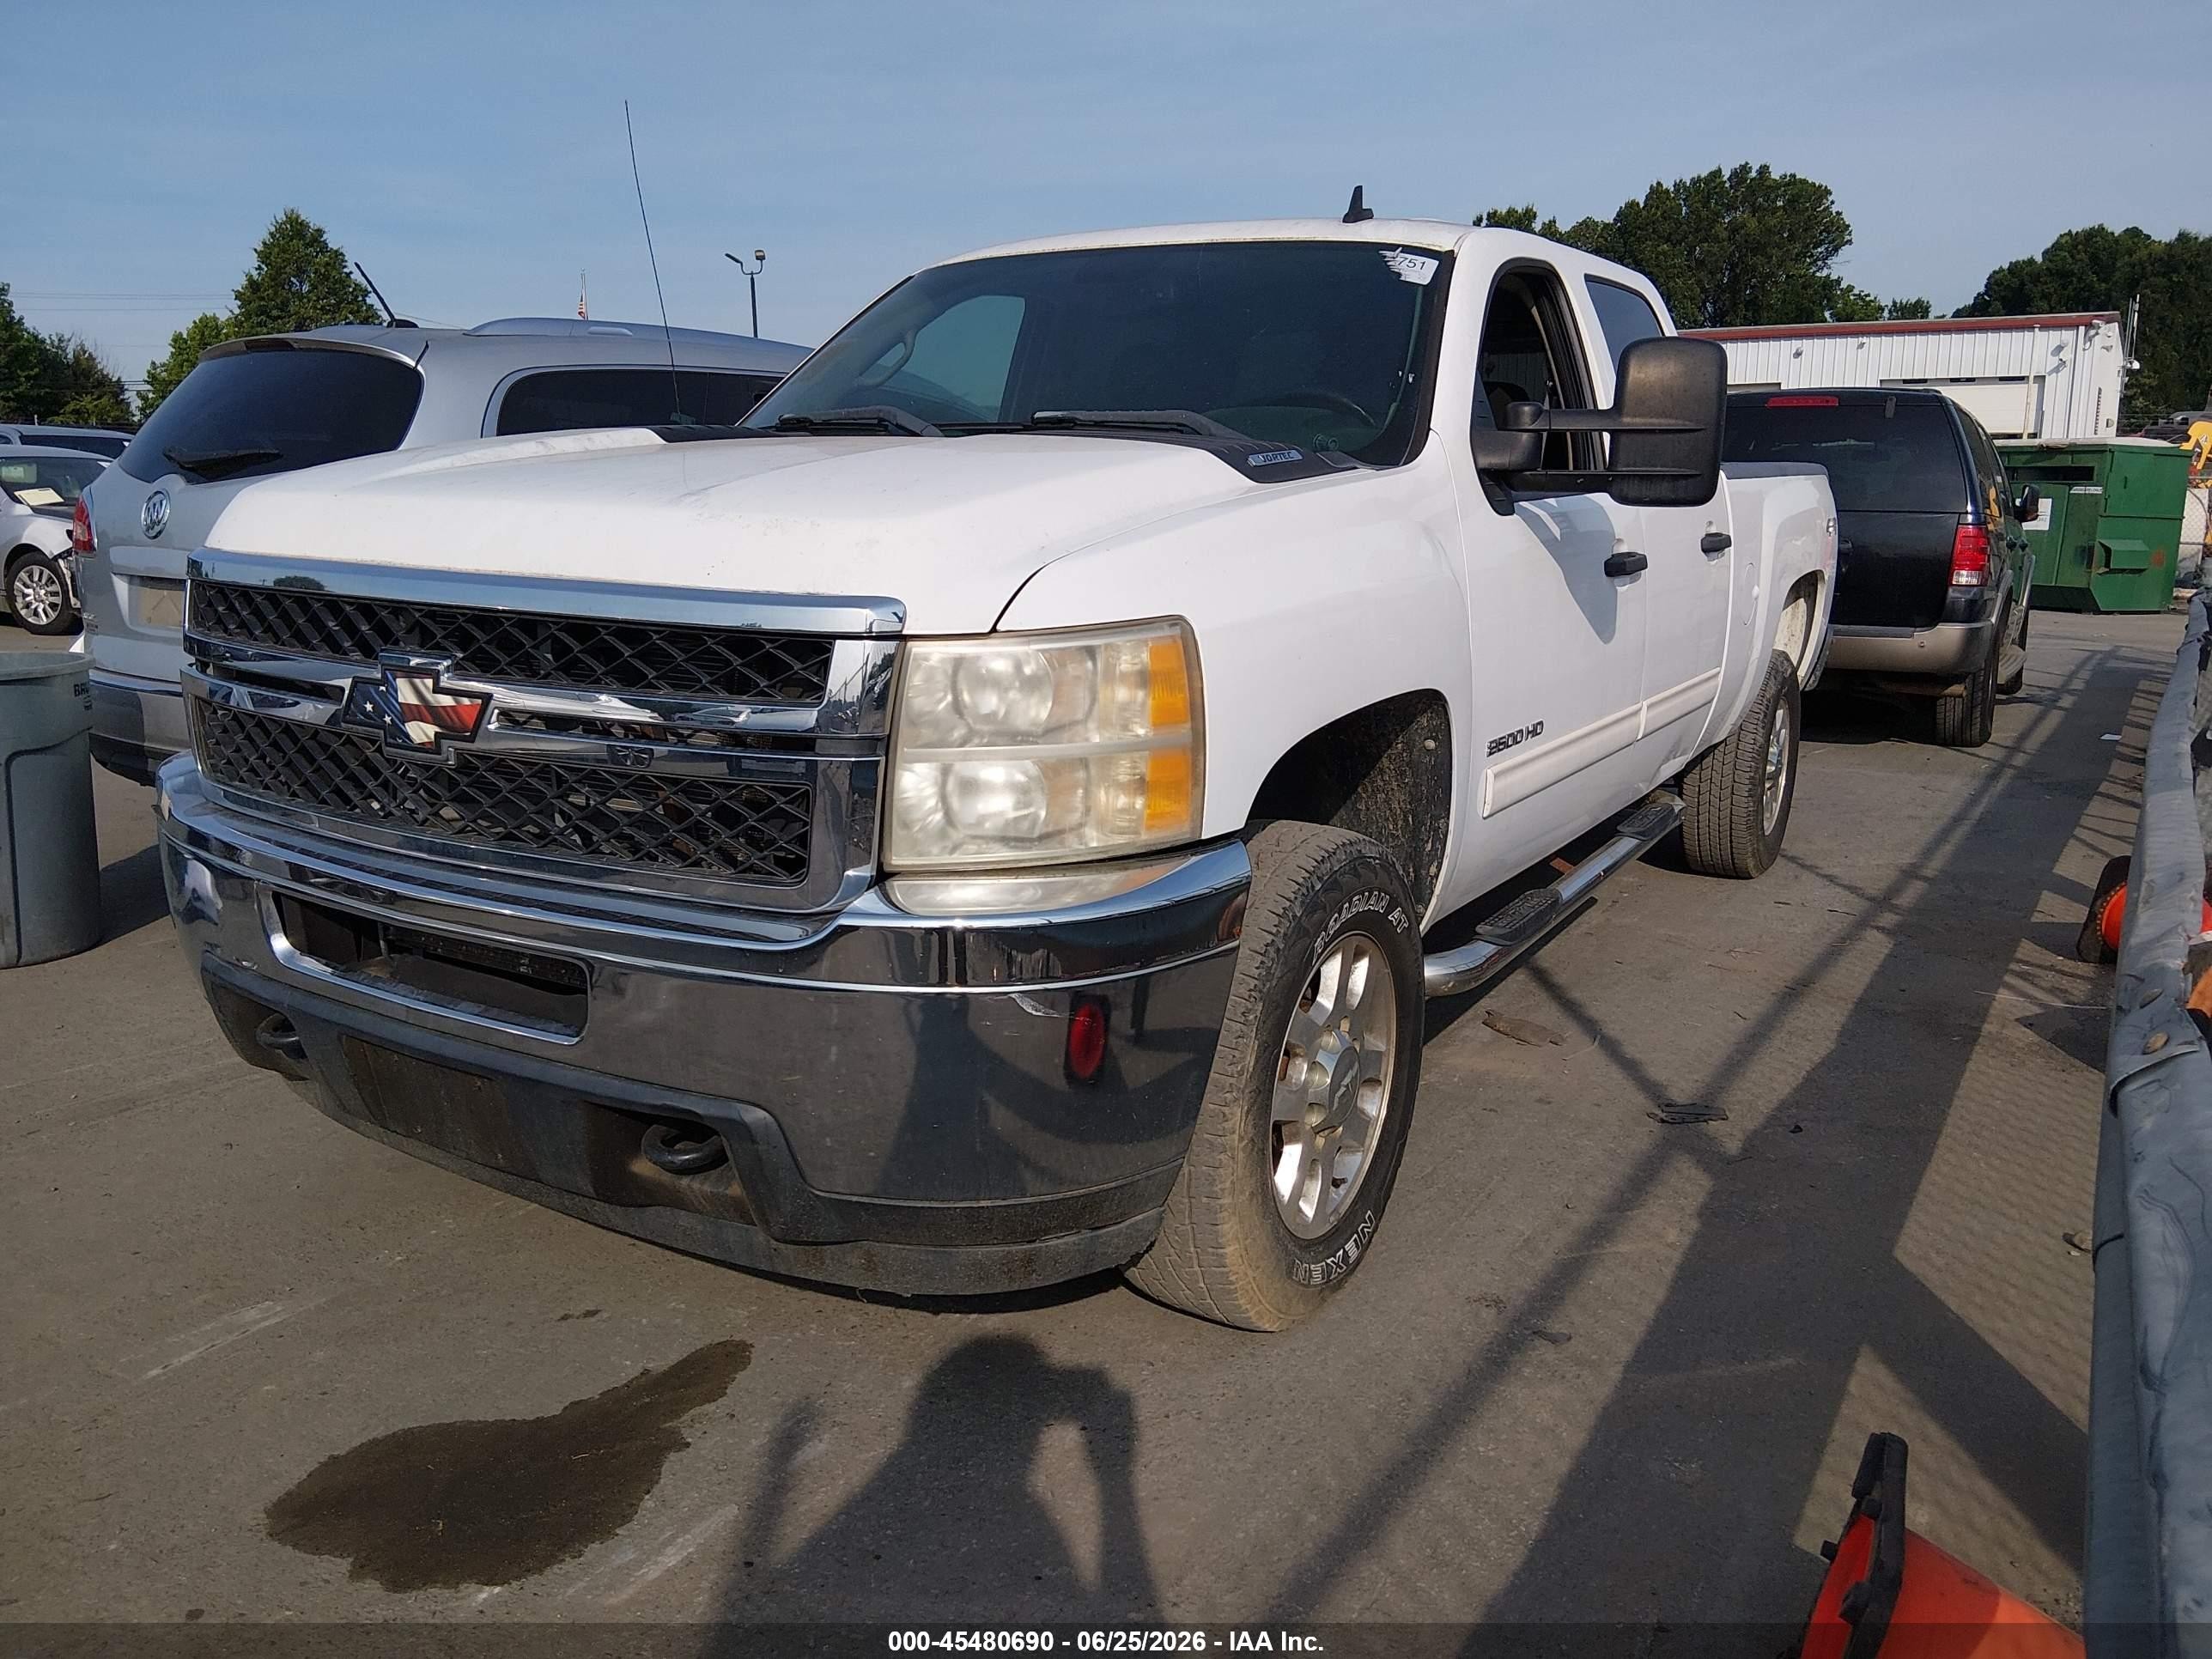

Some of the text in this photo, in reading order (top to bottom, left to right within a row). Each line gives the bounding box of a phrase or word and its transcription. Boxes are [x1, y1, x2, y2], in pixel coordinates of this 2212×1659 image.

[1258, 451, 1295, 463] VORTEC
[1486, 720, 1544, 757] 2500 HD
[1311, 890, 1409, 967] ROADIAN AT
[1292, 1210, 1375, 1285] NEXEN
